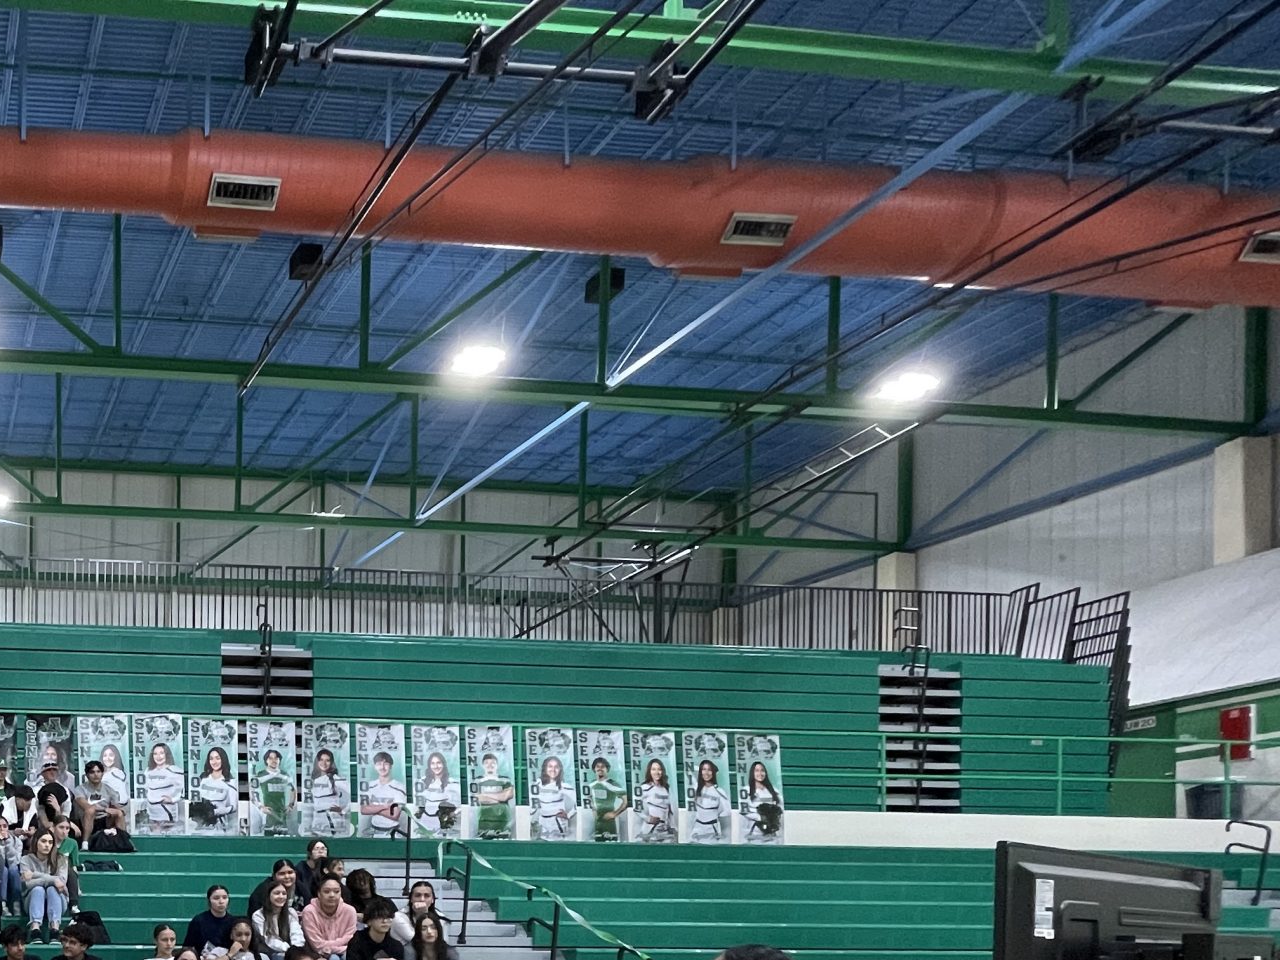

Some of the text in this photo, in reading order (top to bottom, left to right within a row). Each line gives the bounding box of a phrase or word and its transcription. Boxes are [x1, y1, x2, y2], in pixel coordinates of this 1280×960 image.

[134, 718, 148, 799] SENIOR
[190, 720, 204, 803] SENIOR
[248, 723, 262, 803] SENIOR
[303, 724, 315, 804] SENIOR
[358, 725, 370, 806] SENIOR
[467, 728, 480, 807] SENIOR
[528, 731, 542, 809] SENIOR
[578, 732, 593, 810] SENIOR
[631, 733, 644, 812] SENIOR
[684, 735, 697, 812] SENIOR
[736, 736, 750, 814] SENIOR
